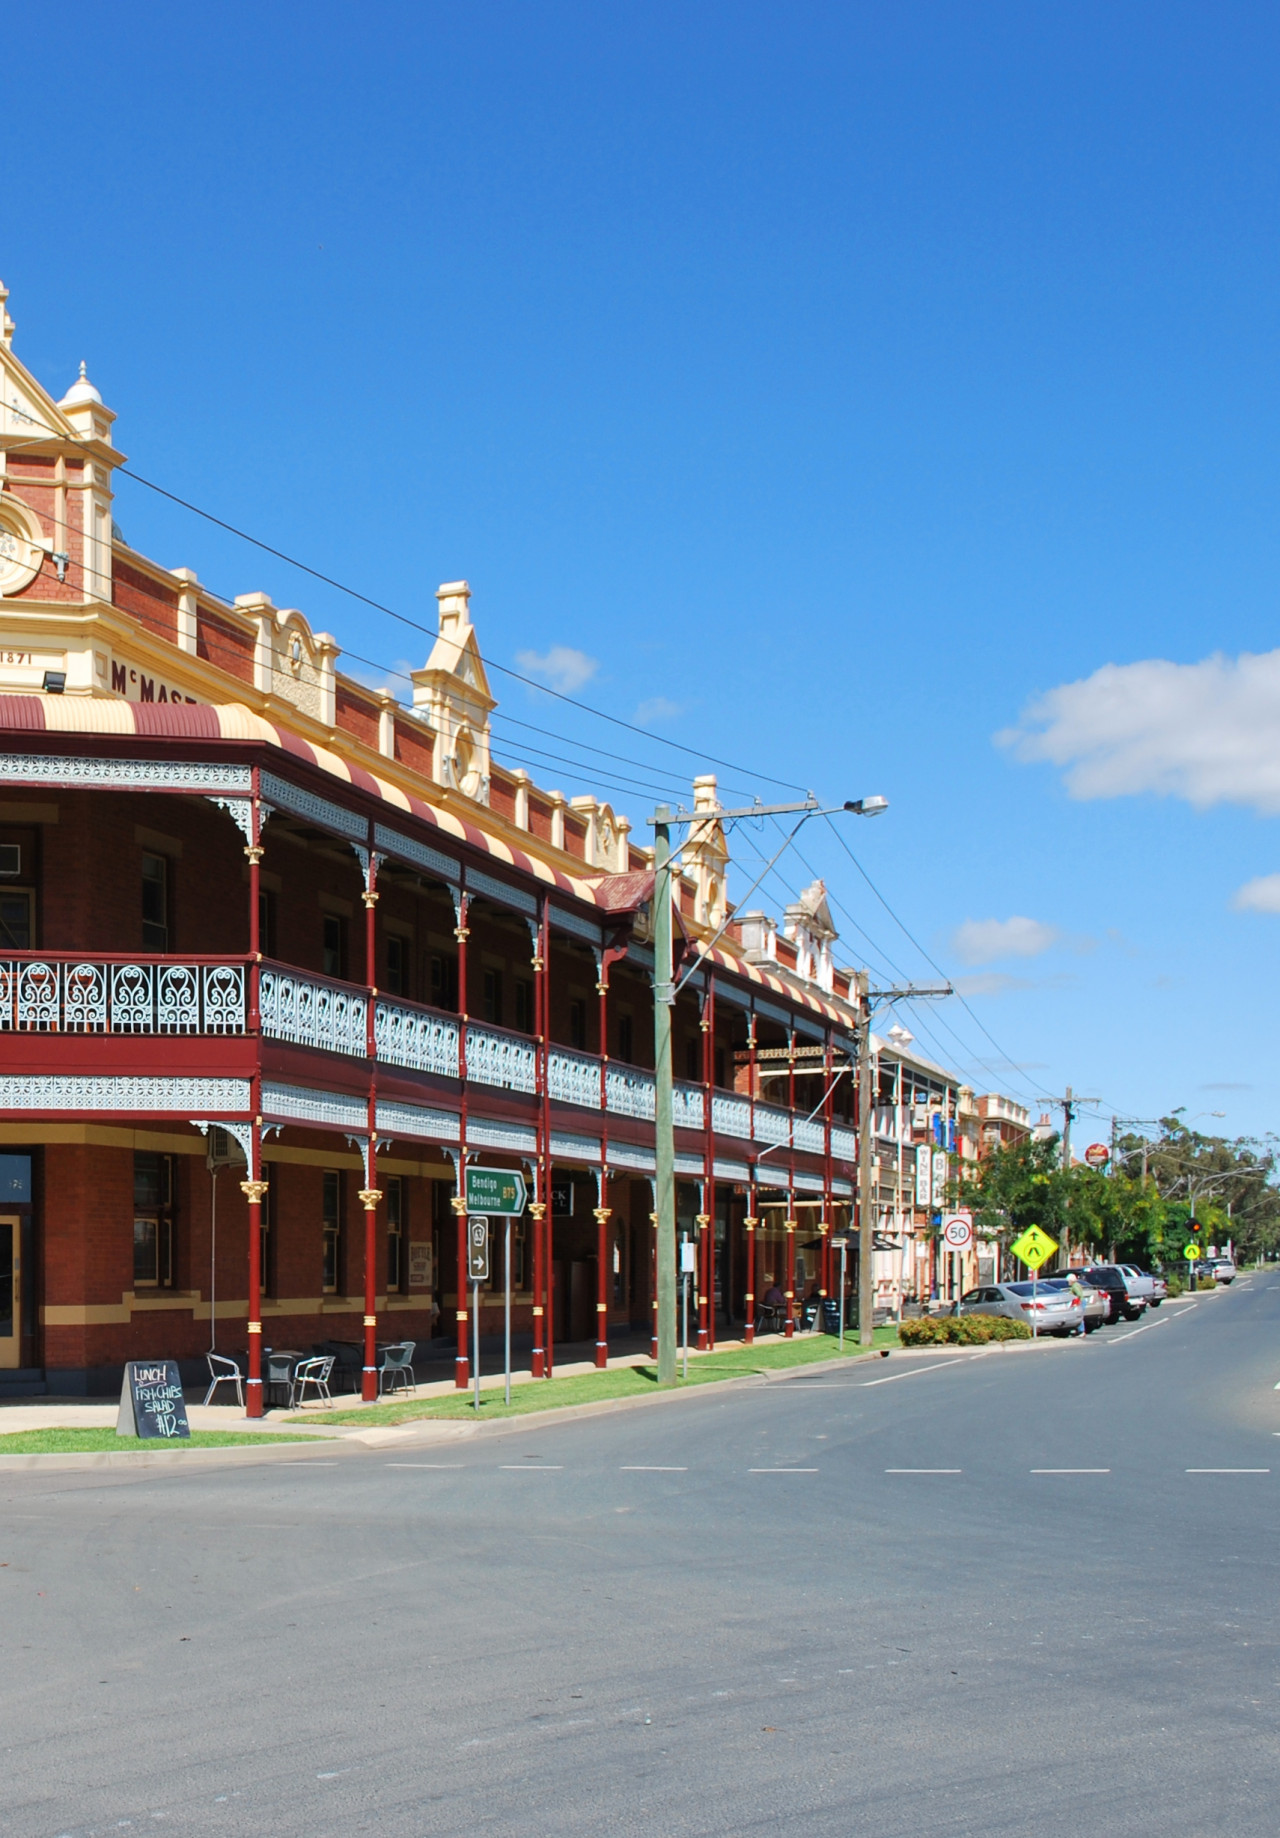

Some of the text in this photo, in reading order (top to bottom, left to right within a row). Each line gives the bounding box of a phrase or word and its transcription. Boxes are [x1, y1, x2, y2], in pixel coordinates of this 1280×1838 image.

[0, 651, 32, 665] 1871
[472, 1175, 498, 1192] Bendigo
[468, 1192, 501, 1207] Melbourne
[950, 1226, 967, 1239] 50
[134, 1364, 167, 1382] LUNCH
[144, 1400, 176, 1414] SALAD
